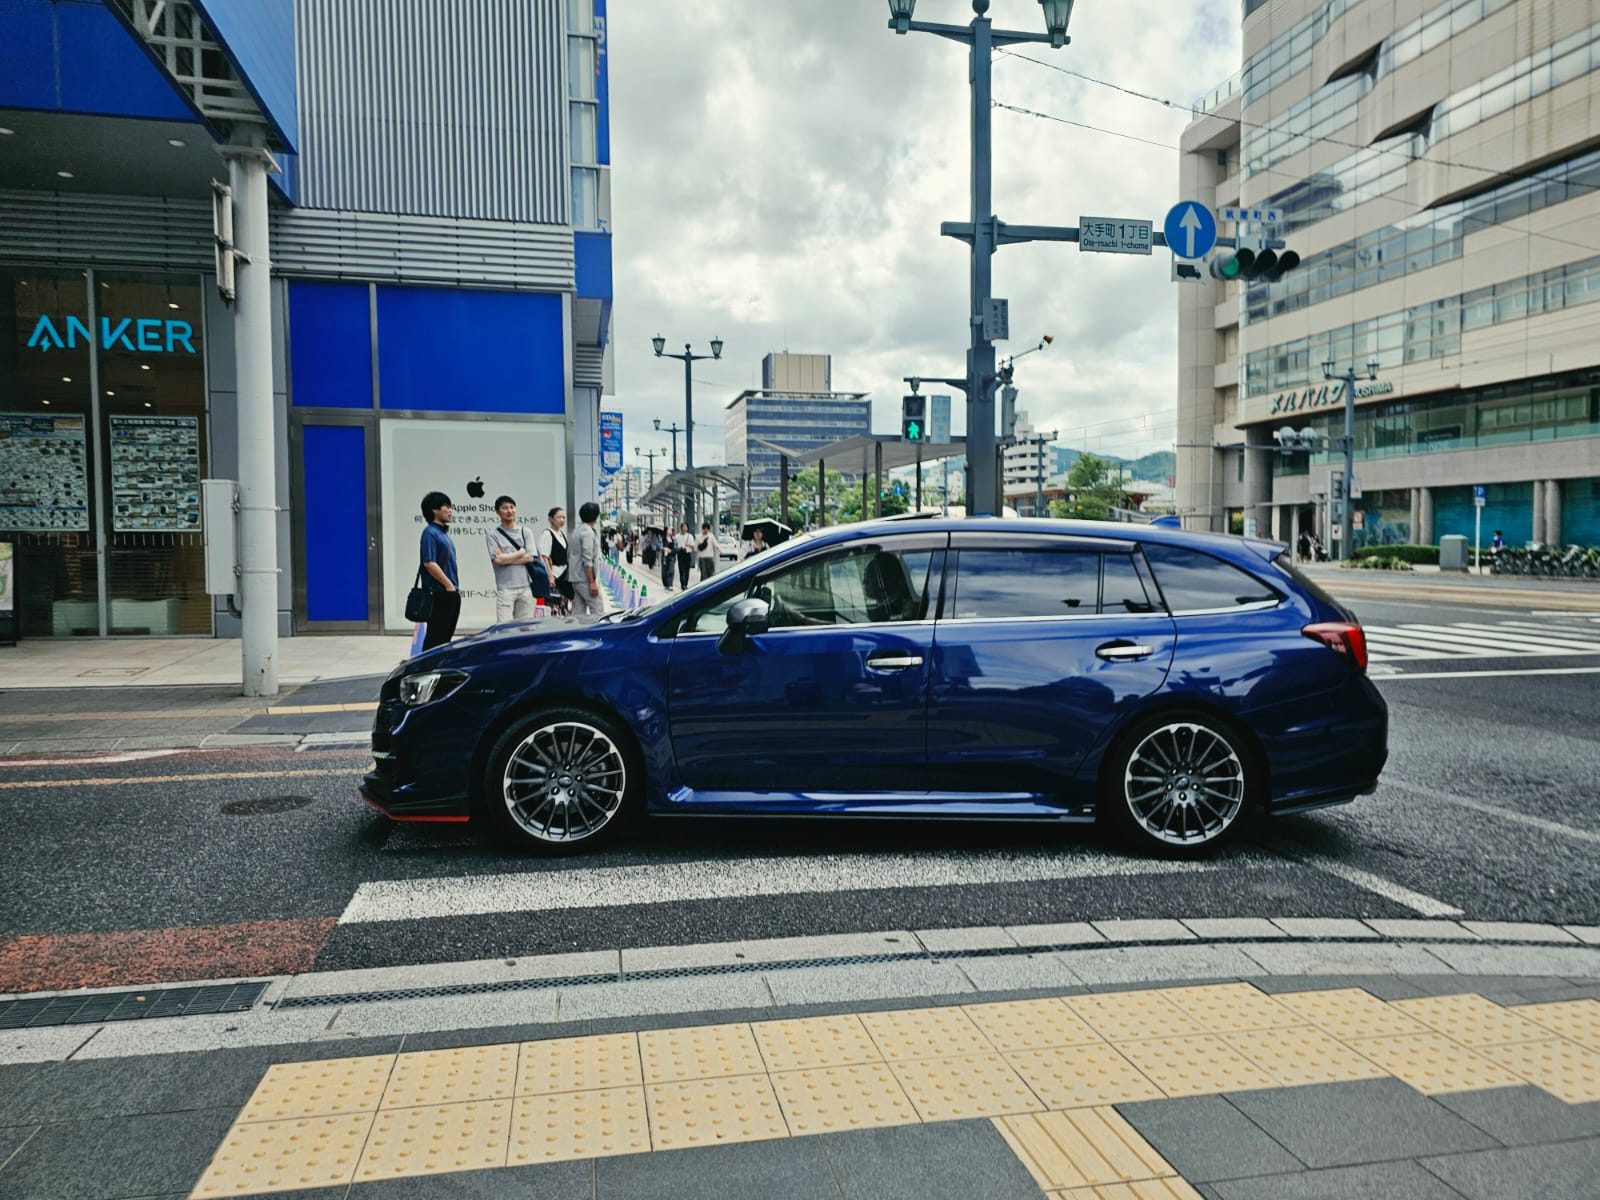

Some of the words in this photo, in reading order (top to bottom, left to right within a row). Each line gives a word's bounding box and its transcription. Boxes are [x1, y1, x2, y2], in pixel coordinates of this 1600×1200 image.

[1083, 221, 1149, 240] 大手町1丁目
[27, 314, 197, 354] ANKER
[1271, 379, 1346, 415] メルパルク
[451, 503, 477, 513] Apple
[479, 503, 496, 513] Sho
